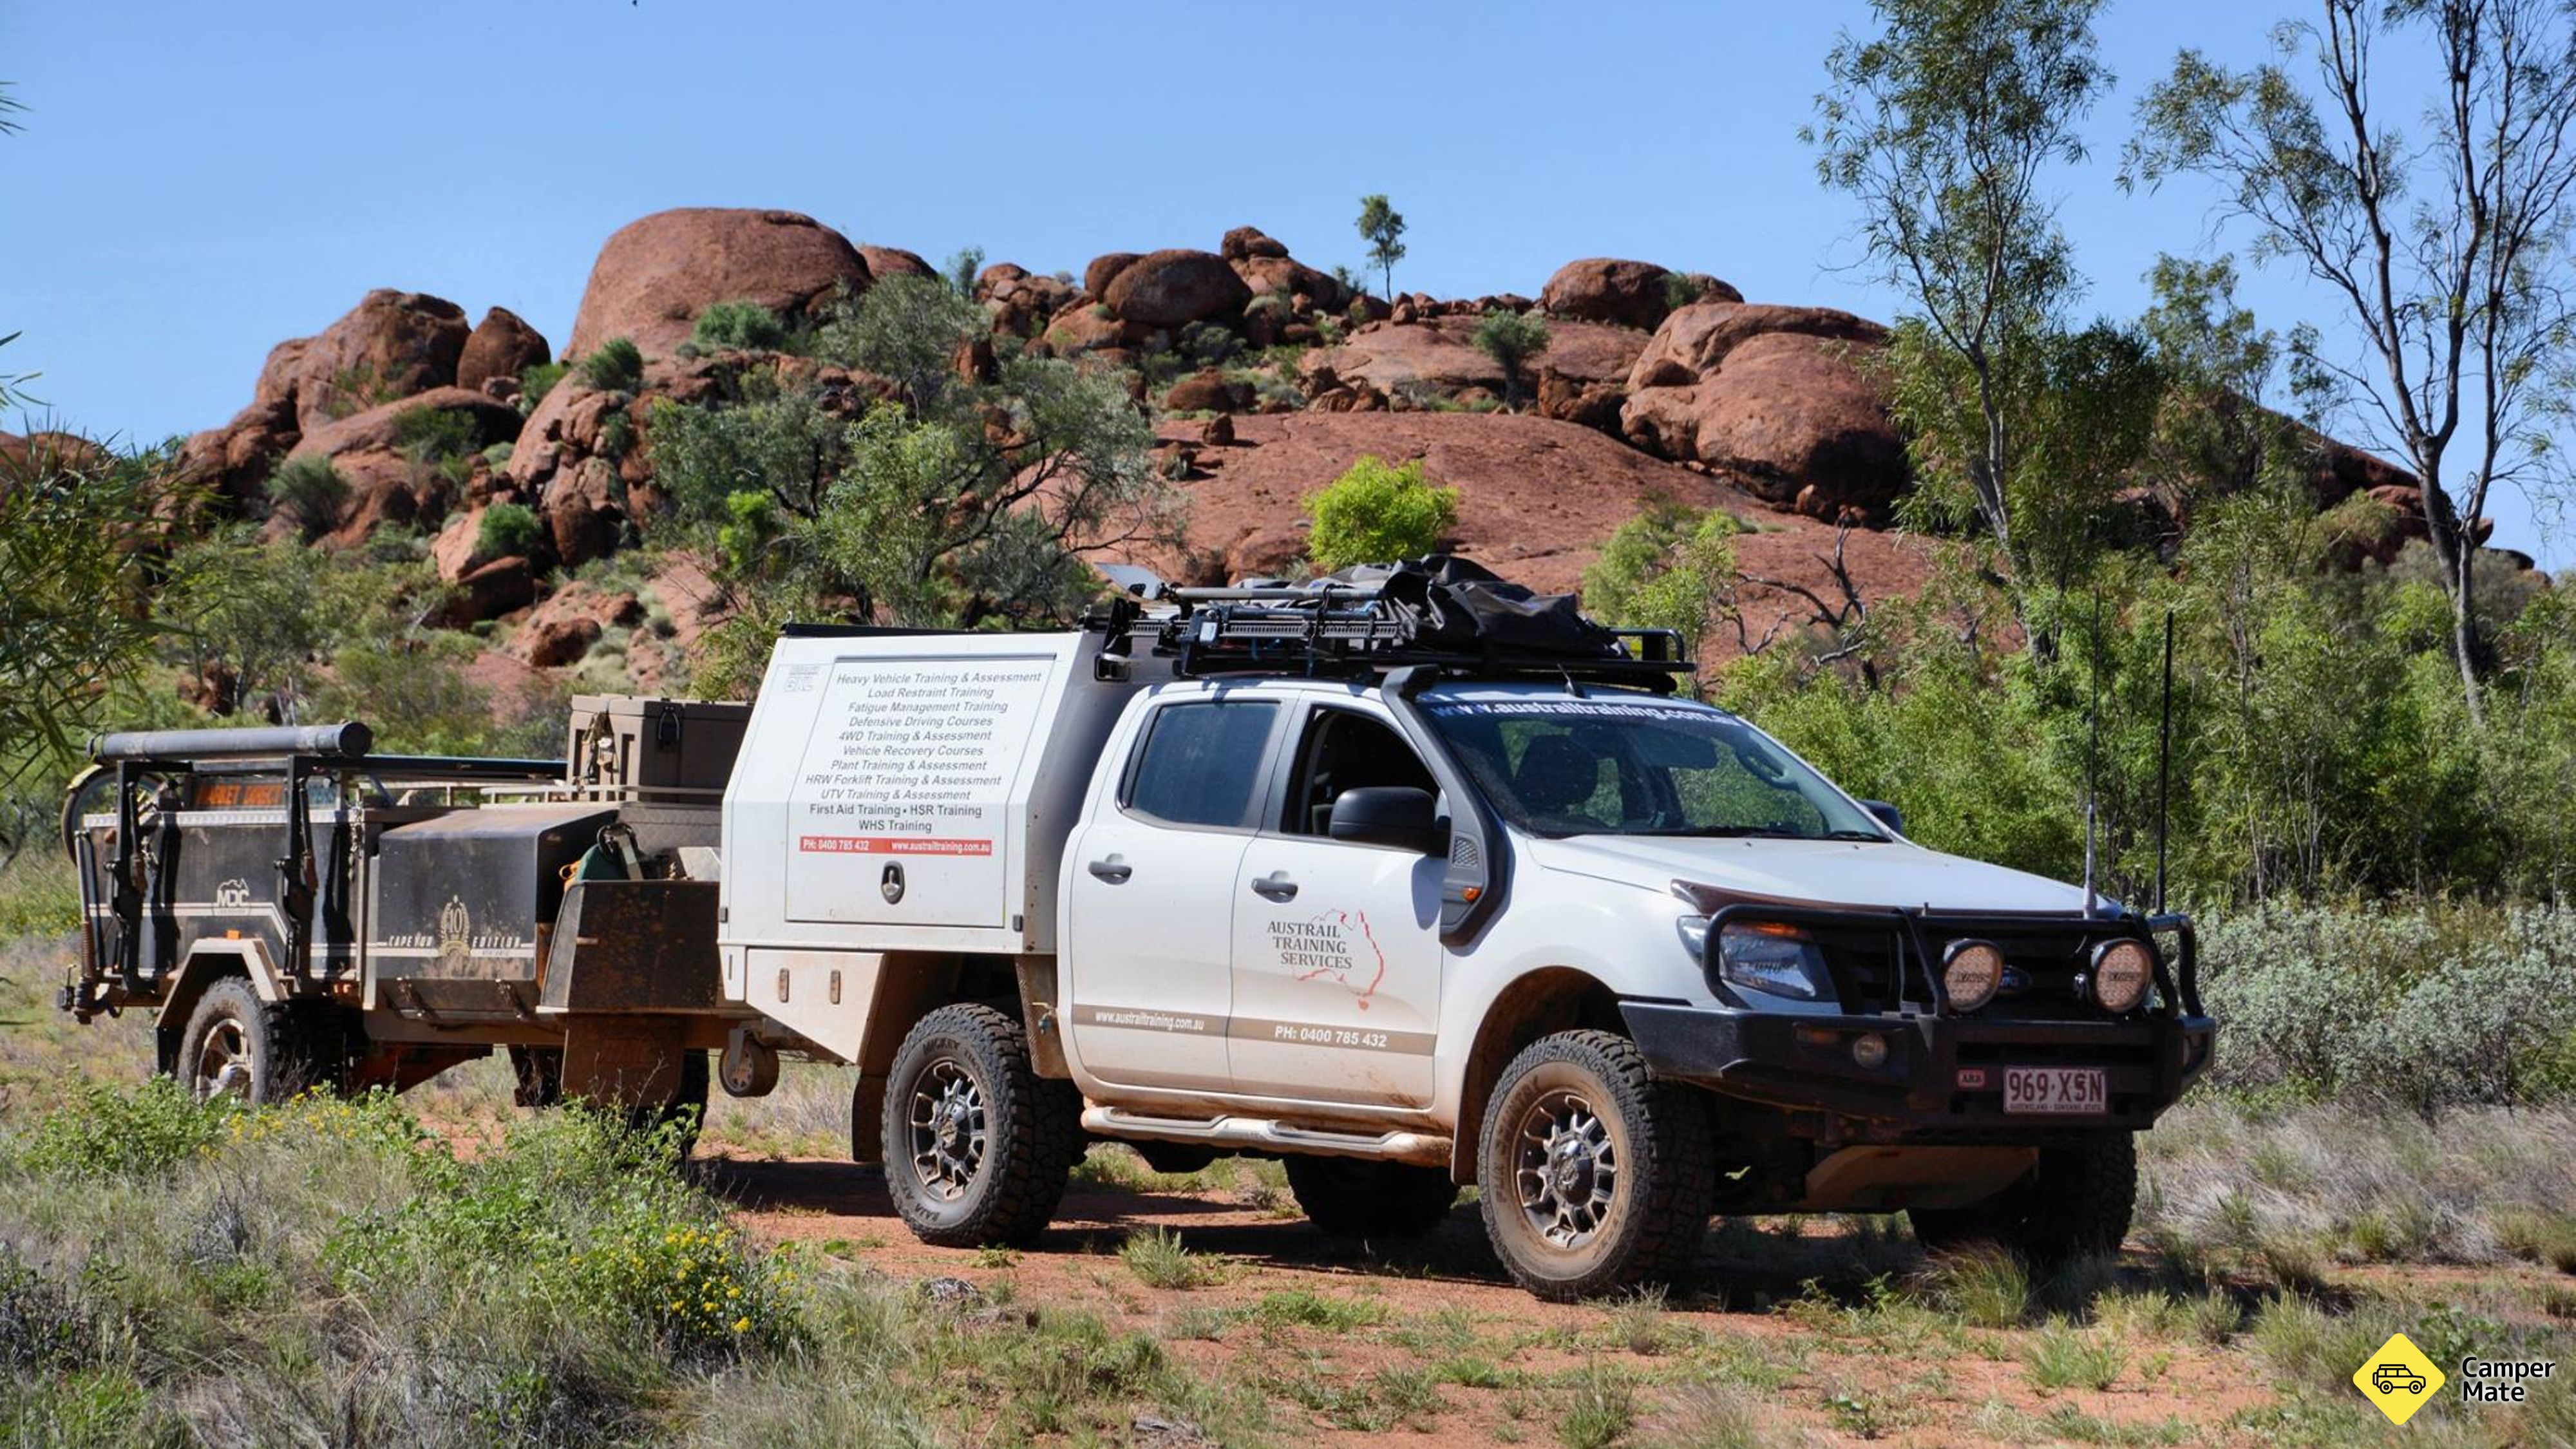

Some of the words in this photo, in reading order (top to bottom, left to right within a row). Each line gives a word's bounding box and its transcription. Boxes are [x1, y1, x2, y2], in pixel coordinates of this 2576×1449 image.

[837, 675, 869, 686] Heavy
[873, 674, 910, 684] Vehicle
[914, 674, 957, 685] Training
[961, 674, 969, 683] &
[971, 672, 1042, 683] Assessment
[867, 688, 895, 697] Load
[900, 688, 947, 697] Restraint
[950, 688, 994, 700] Training
[848, 703, 887, 714] Fatigue
[891, 702, 960, 714] Management
[963, 702, 1008, 714] Training
[849, 717, 901, 726] Defensive
[905, 717, 943, 728] Driving
[947, 716, 993, 726] Courses
[838, 732, 864, 741] 4WD
[867, 731, 909, 743] Training
[912, 732, 920, 741] &
[923, 731, 991, 741] Assessment
[843, 746, 880, 755] Vehicle
[884, 746, 934, 758] Recovery
[938, 746, 983, 755] Courses
[831, 760, 858, 770] Plant
[863, 761, 904, 773] Training
[907, 760, 914, 770] &
[918, 760, 987, 770] Assessment
[805, 775, 831, 784] HRW
[835, 775, 872, 784] Forklift
[876, 775, 918, 786] Training
[921, 775, 929, 785] &
[932, 775, 1001, 786] Assessment
[821, 790, 843, 799] UTV
[848, 790, 889, 801] Training
[893, 790, 900, 799] &
[903, 790, 971, 799] Assessment
[810, 804, 835, 814] First
[837, 805, 854, 815] Aid
[858, 805, 900, 817] Training
[910, 805, 934, 815] HSR
[938, 806, 981, 818] Training
[858, 820, 884, 831] WHS
[889, 821, 932, 833] Training
[803, 839, 817, 849] PH:
[819, 839, 837, 850] 0400
[838, 840, 853, 851] 785
[855, 840, 869, 851] 432
[218, 889, 249, 907] MDC
[449, 908, 462, 933] 10
[1267, 920, 1340, 938] AUSTRAIL
[1273, 936, 1347, 954] TRAINING
[1280, 951, 1352, 969] SERVICES
[1274, 1025, 1296, 1039] PH:
[1300, 1027, 1332, 1043] 0400
[1336, 1030, 1359, 1045] 785
[1362, 1034, 1388, 1048] 432
